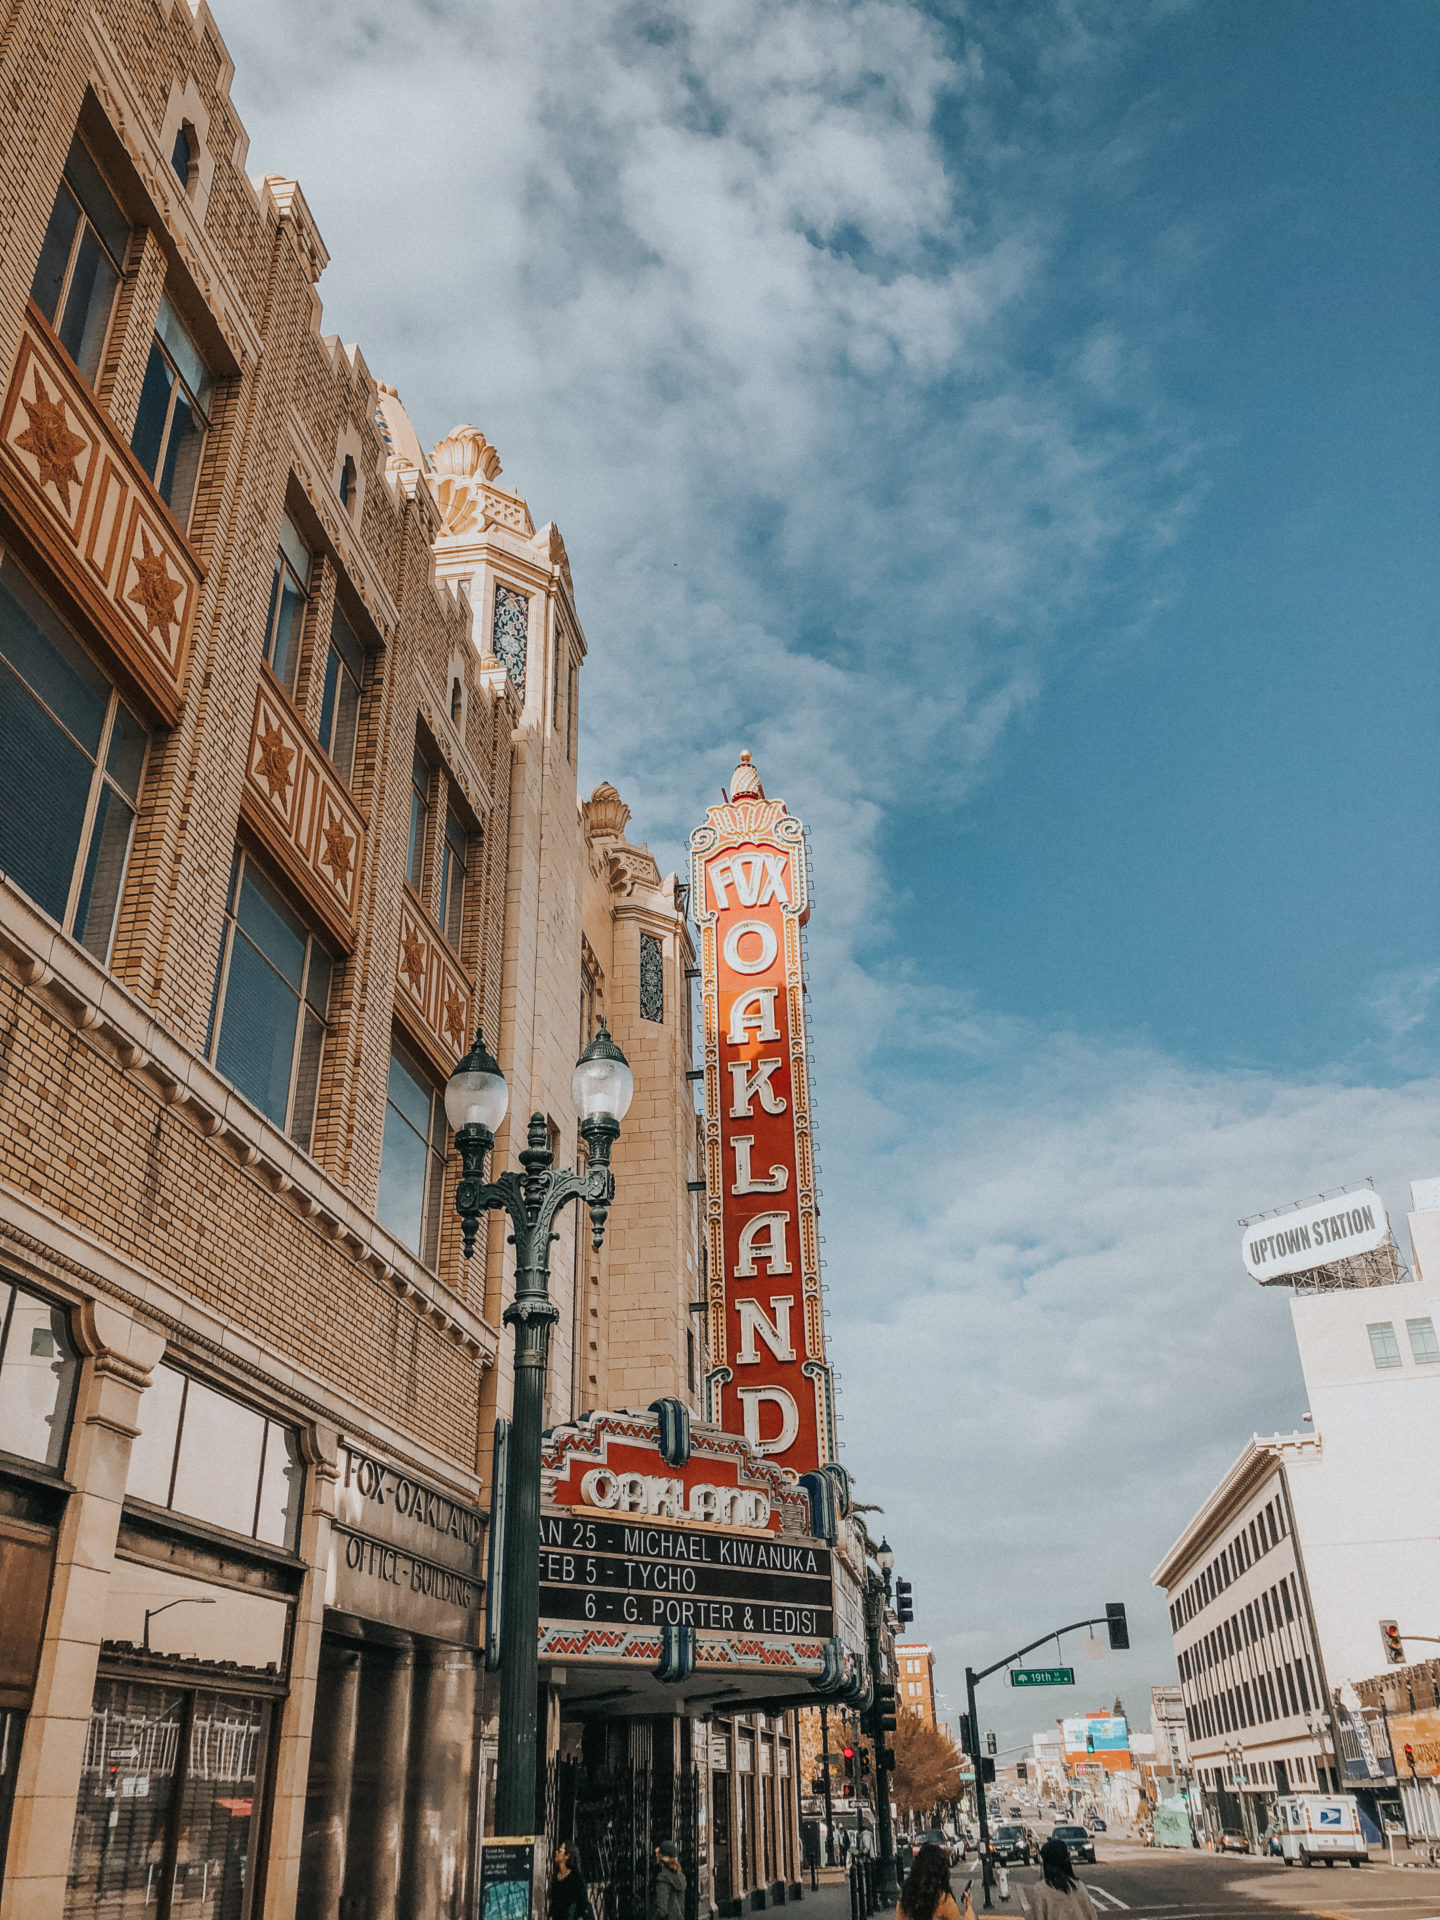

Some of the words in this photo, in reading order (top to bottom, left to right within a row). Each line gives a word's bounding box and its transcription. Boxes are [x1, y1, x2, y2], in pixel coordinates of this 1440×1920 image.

[712, 851, 790, 909] FOX
[722, 918, 800, 1458] OAKLAND
[1249, 1224, 1312, 1266] UPTOWN
[1312, 1204, 1376, 1247] STATION
[580, 1467, 771, 1529] OAKLAND
[539, 1519, 562, 1545] AN
[572, 1522, 596, 1549] 25
[625, 1528, 711, 1562] MICHAEL
[720, 1540, 817, 1572] KIWANUKA
[539, 1553, 575, 1581] FEB
[586, 1558, 596, 1584] 5
[624, 1562, 696, 1592] TYCHO
[585, 1593, 596, 1619] 6
[623, 1597, 643, 1622] G.
[652, 1599, 733, 1629] PORTER
[743, 1606, 754, 1630] &
[763, 1609, 817, 1634] LEDISI
[1031, 1672, 1051, 1682] 19th
